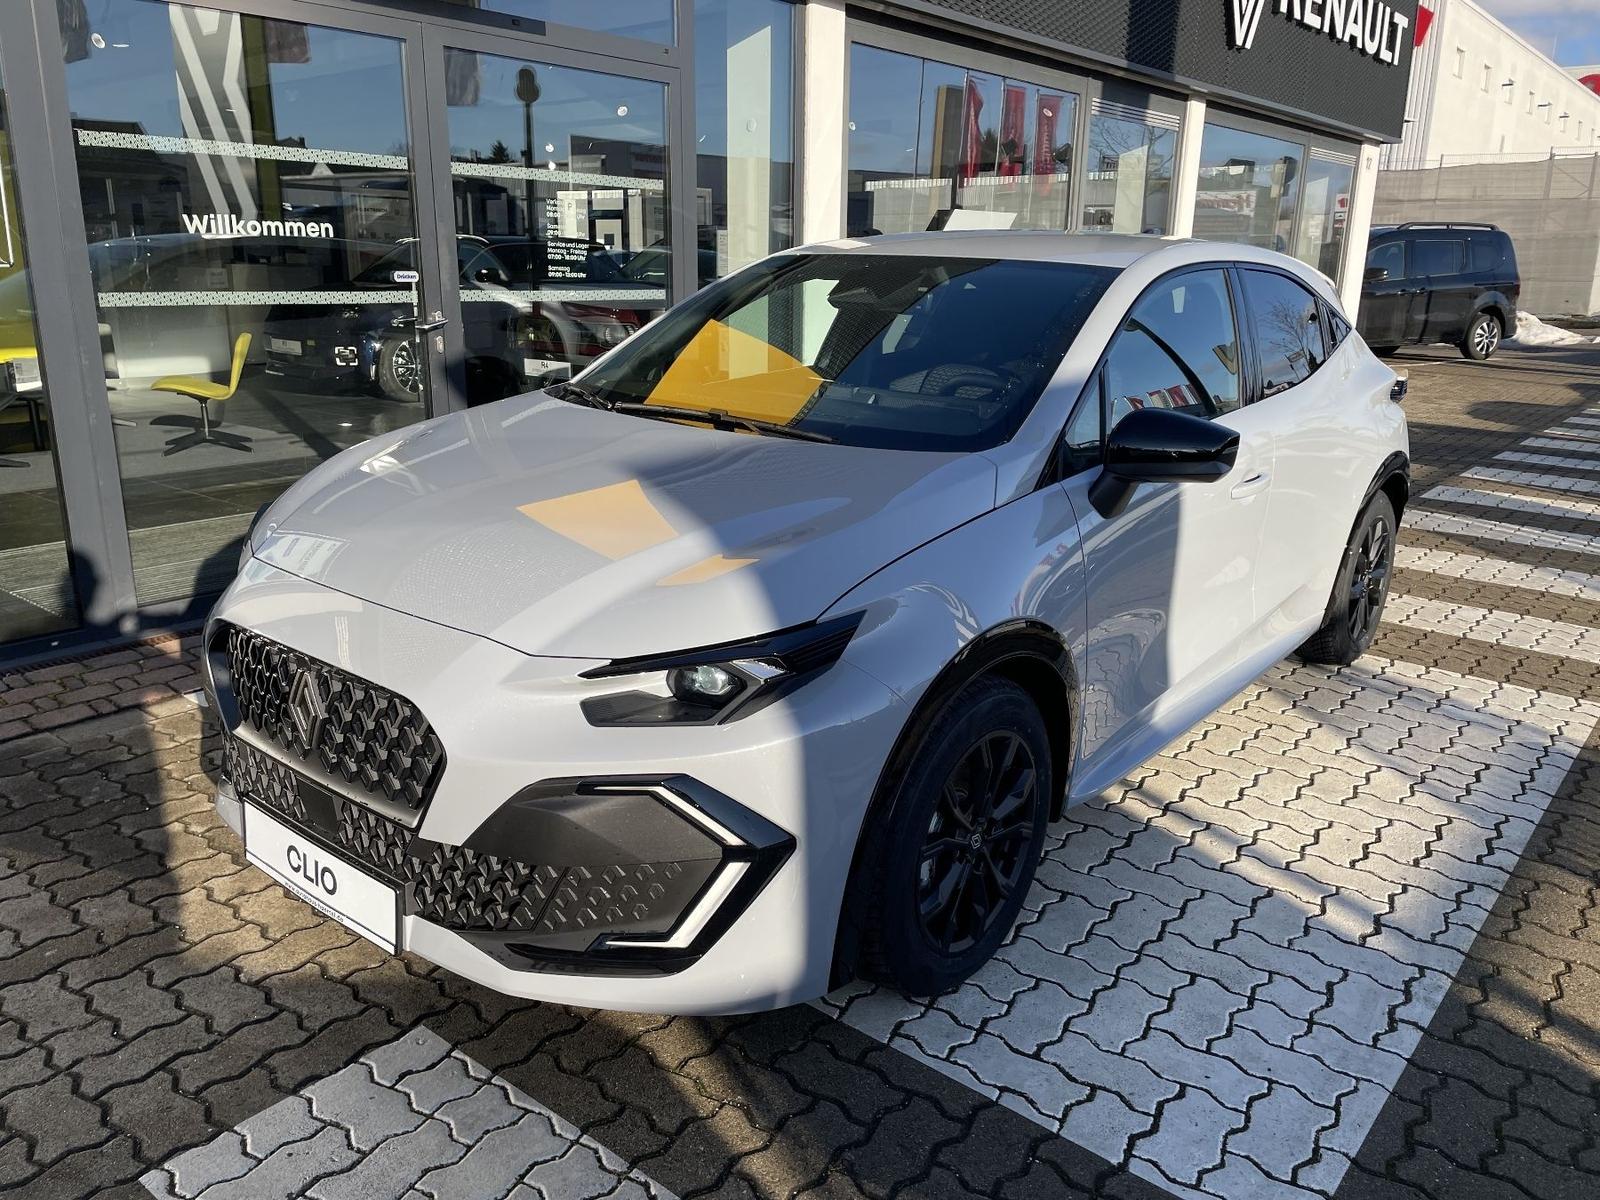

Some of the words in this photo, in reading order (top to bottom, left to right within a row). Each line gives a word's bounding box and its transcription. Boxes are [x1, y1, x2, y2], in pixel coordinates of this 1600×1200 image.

[182, 213, 334, 239] Willkommen
[570, 248, 587, 256] Freitag
[548, 264, 570, 272] Samstag
[287, 844, 338, 896] CLIO
